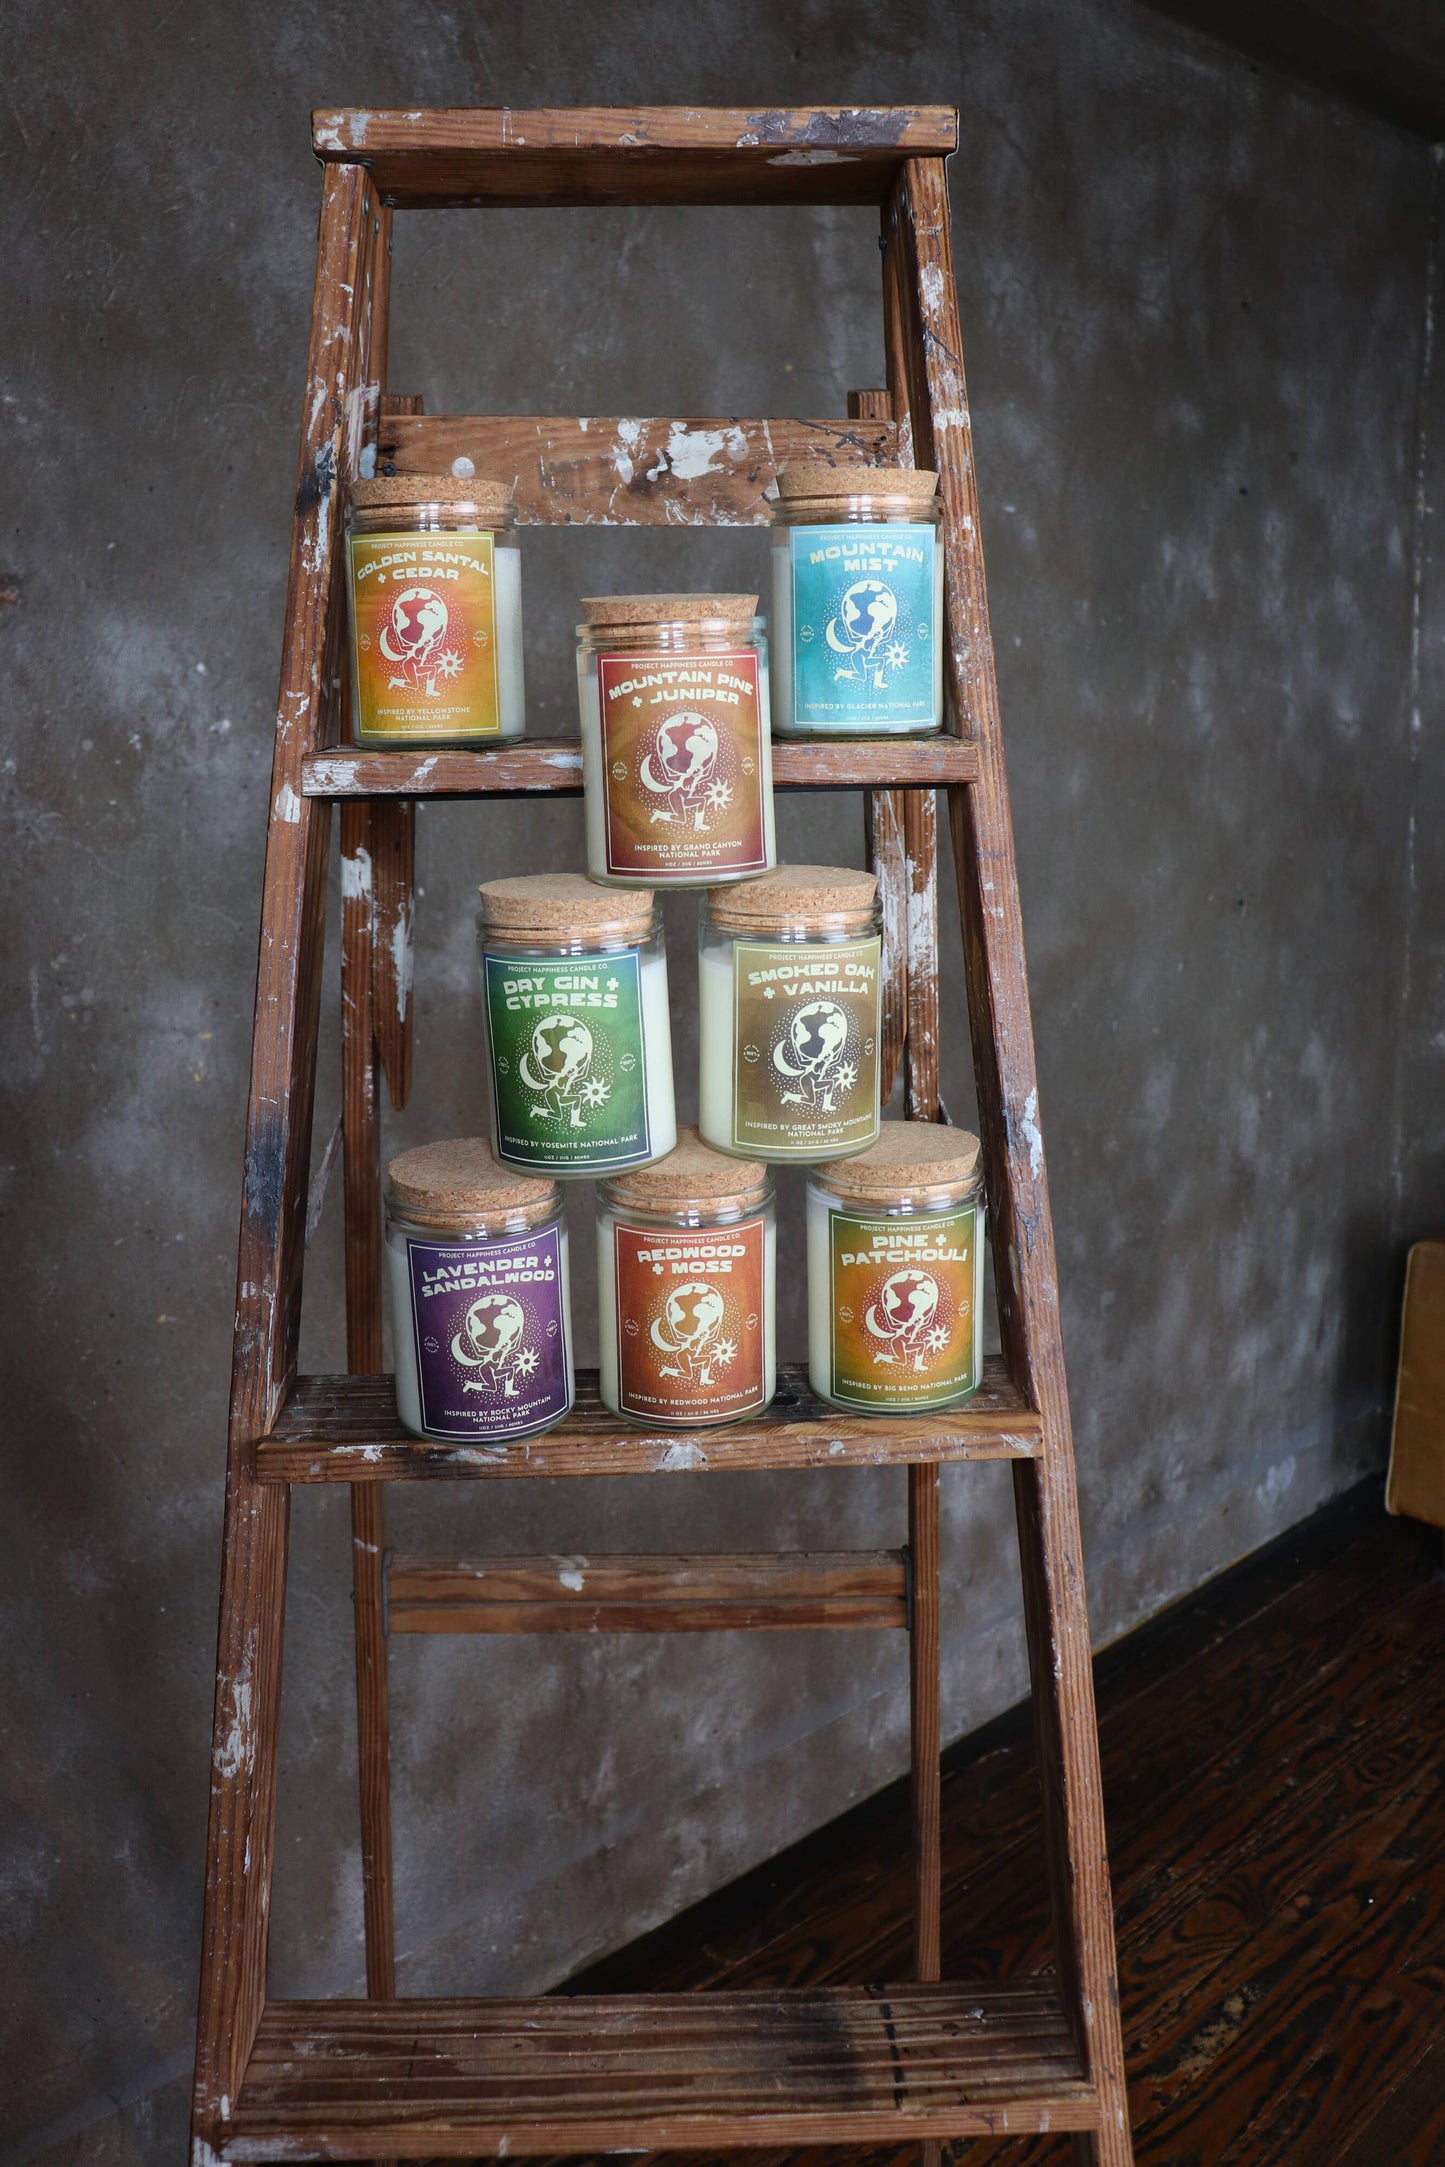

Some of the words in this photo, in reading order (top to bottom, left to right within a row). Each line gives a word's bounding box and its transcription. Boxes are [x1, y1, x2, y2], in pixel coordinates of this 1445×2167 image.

[809, 543, 924, 564] MOUNTAIN
[358, 552, 417, 580] GOLDEN
[422, 551, 488, 575] SANTAL
[392, 567, 459, 580] CEDAR
[844, 559, 898, 572] MIST
[608, 671, 712, 700] MOUNTAIN
[717, 673, 753, 696] PINE
[651, 688, 739, 704] JUNIPER
[712, 840, 742, 848] CANYON
[748, 963, 839, 986] SMOKED
[845, 963, 875, 979] OAK
[503, 977, 546, 995] DRY
[554, 976, 598, 990] GIN
[783, 980, 868, 996] VANILLA
[506, 993, 618, 1010] CYPRESS
[745, 1121, 778, 1130] INSPIRED
[818, 1121, 842, 1130] SMOKY
[504, 1136, 529, 1146] INSPIRED
[580, 1138, 619, 1148] NATIONAL
[621, 1134, 638, 1143] PARK
[860, 1224, 886, 1232] PROJECT
[922, 1223, 945, 1231] CANDLE
[706, 1235, 731, 1243] CANDLE
[872, 1234, 928, 1248] PINE
[466, 1250, 502, 1258] HAPPINESS
[503, 1245, 527, 1254] CANDLE
[637, 1245, 746, 1263] REDWOOD
[840, 1248, 967, 1266] PATCHOULI
[423, 1256, 538, 1282] LAVENDER
[671, 1260, 733, 1274] MOSS
[421, 1270, 555, 1298] SANDALWOOD
[842, 1378, 871, 1390] INSPIRED
[920, 1379, 953, 1390] NATIONAL
[954, 1373, 967, 1383] PARK
[629, 1392, 657, 1403] INSPIRED
[710, 1392, 744, 1403] NATIONAL
[745, 1386, 758, 1395] PARK
[491, 1407, 516, 1416] ROCKY
[517, 1395, 551, 1411] MOUNTAIN
[473, 1415, 511, 1423] NATIONAL
